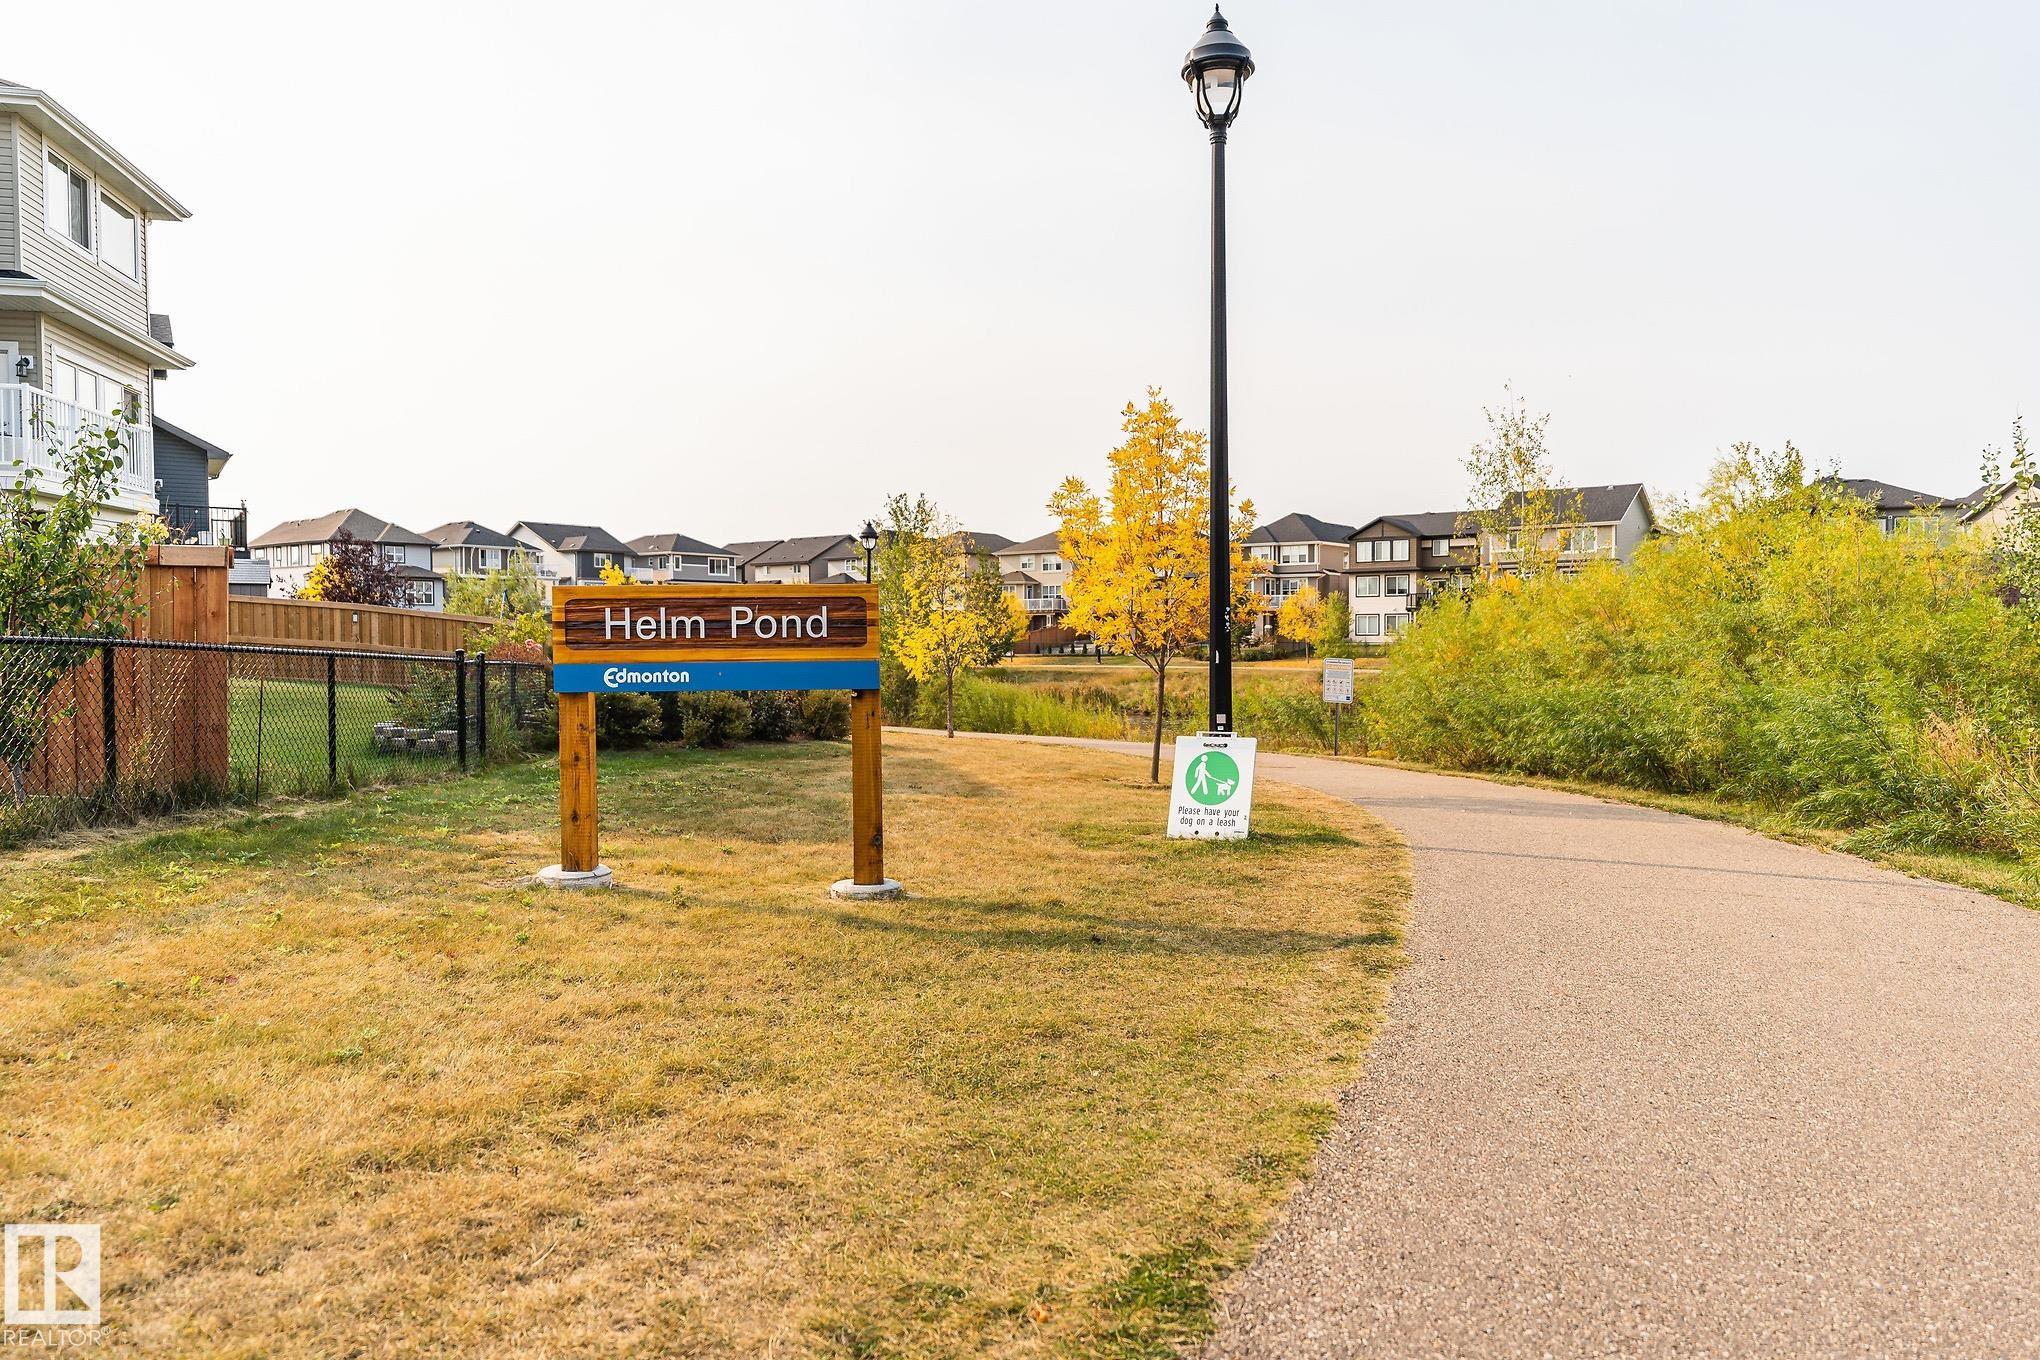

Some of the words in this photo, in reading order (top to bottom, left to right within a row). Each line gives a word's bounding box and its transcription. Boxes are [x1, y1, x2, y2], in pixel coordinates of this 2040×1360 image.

[603, 606, 705, 639] Helm
[730, 605, 829, 638] Pond
[603, 667, 690, 688] Edmonton
[1178, 806, 1201, 816] Please
[1204, 807, 1221, 816] have
[1223, 809, 1240, 818] your
[1180, 816, 1193, 827] dog
[1196, 818, 1206, 826] on
[1208, 818, 1214, 826] a
[1216, 818, 1236, 827] leash
